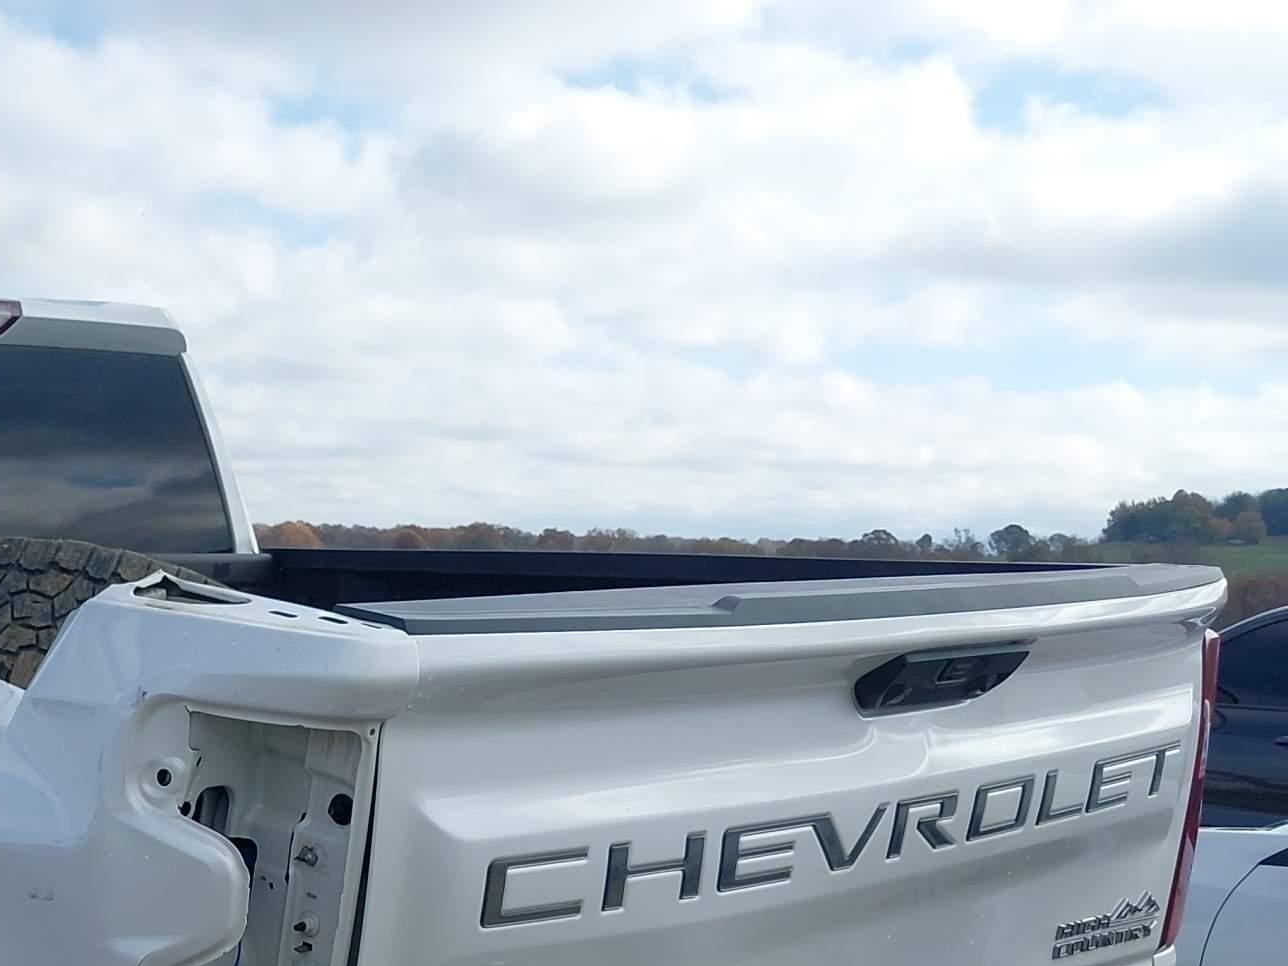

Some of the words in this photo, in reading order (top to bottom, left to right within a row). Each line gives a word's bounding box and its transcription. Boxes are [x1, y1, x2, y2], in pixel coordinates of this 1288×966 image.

[480, 743, 1181, 928] CHEVROLET
[1052, 919, 1158, 960] COUNTRY
[1055, 913, 1112, 941] HIGH
